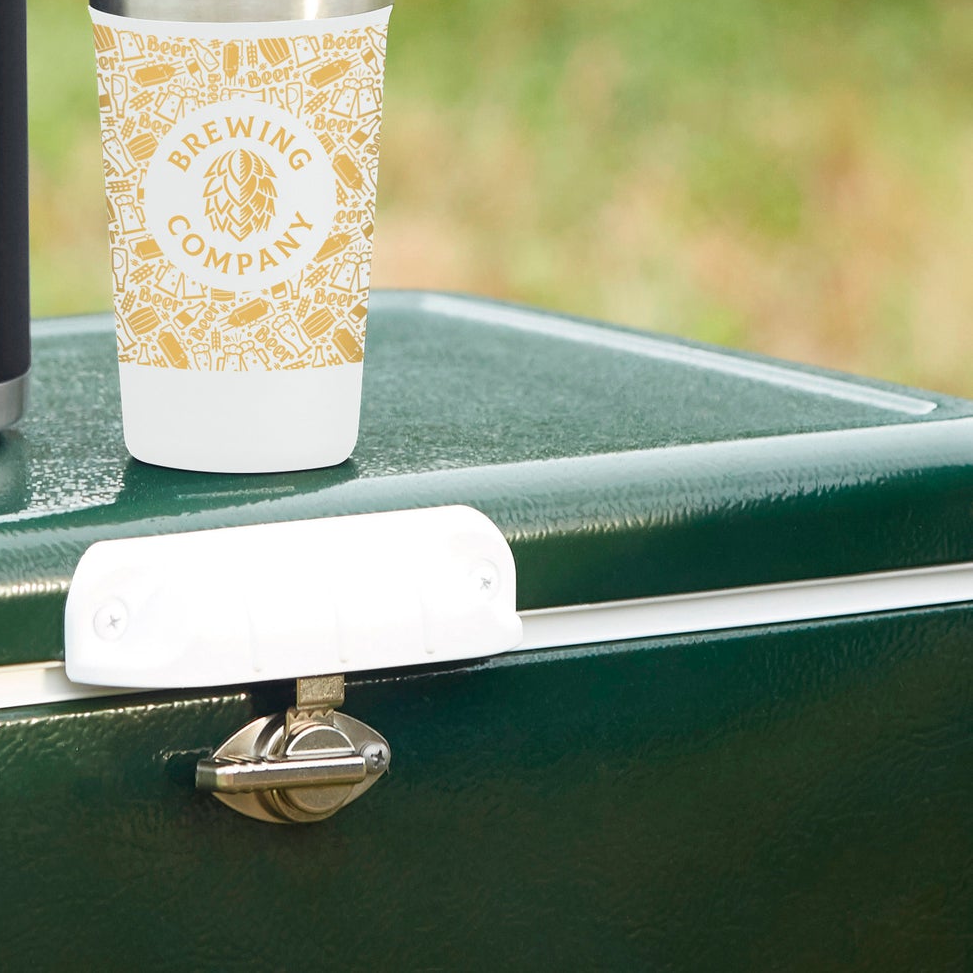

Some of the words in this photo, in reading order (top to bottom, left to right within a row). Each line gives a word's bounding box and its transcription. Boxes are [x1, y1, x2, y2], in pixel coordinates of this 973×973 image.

[146, 35, 192, 58] Beer
[322, 32, 368, 50] Beer
[98, 56, 119, 70] er
[246, 65, 294, 88] Beer
[138, 111, 173, 136] Bee
[313, 113, 358, 133] Beer
[168, 116, 312, 173] BREWING
[334, 209, 368, 224] eer
[168, 212, 313, 275] COMPANY
[139, 285, 183, 312] Beer
[314, 287, 358, 308] Beer
[189, 301, 219, 341] Beer
[254, 324, 294, 362] Beer
